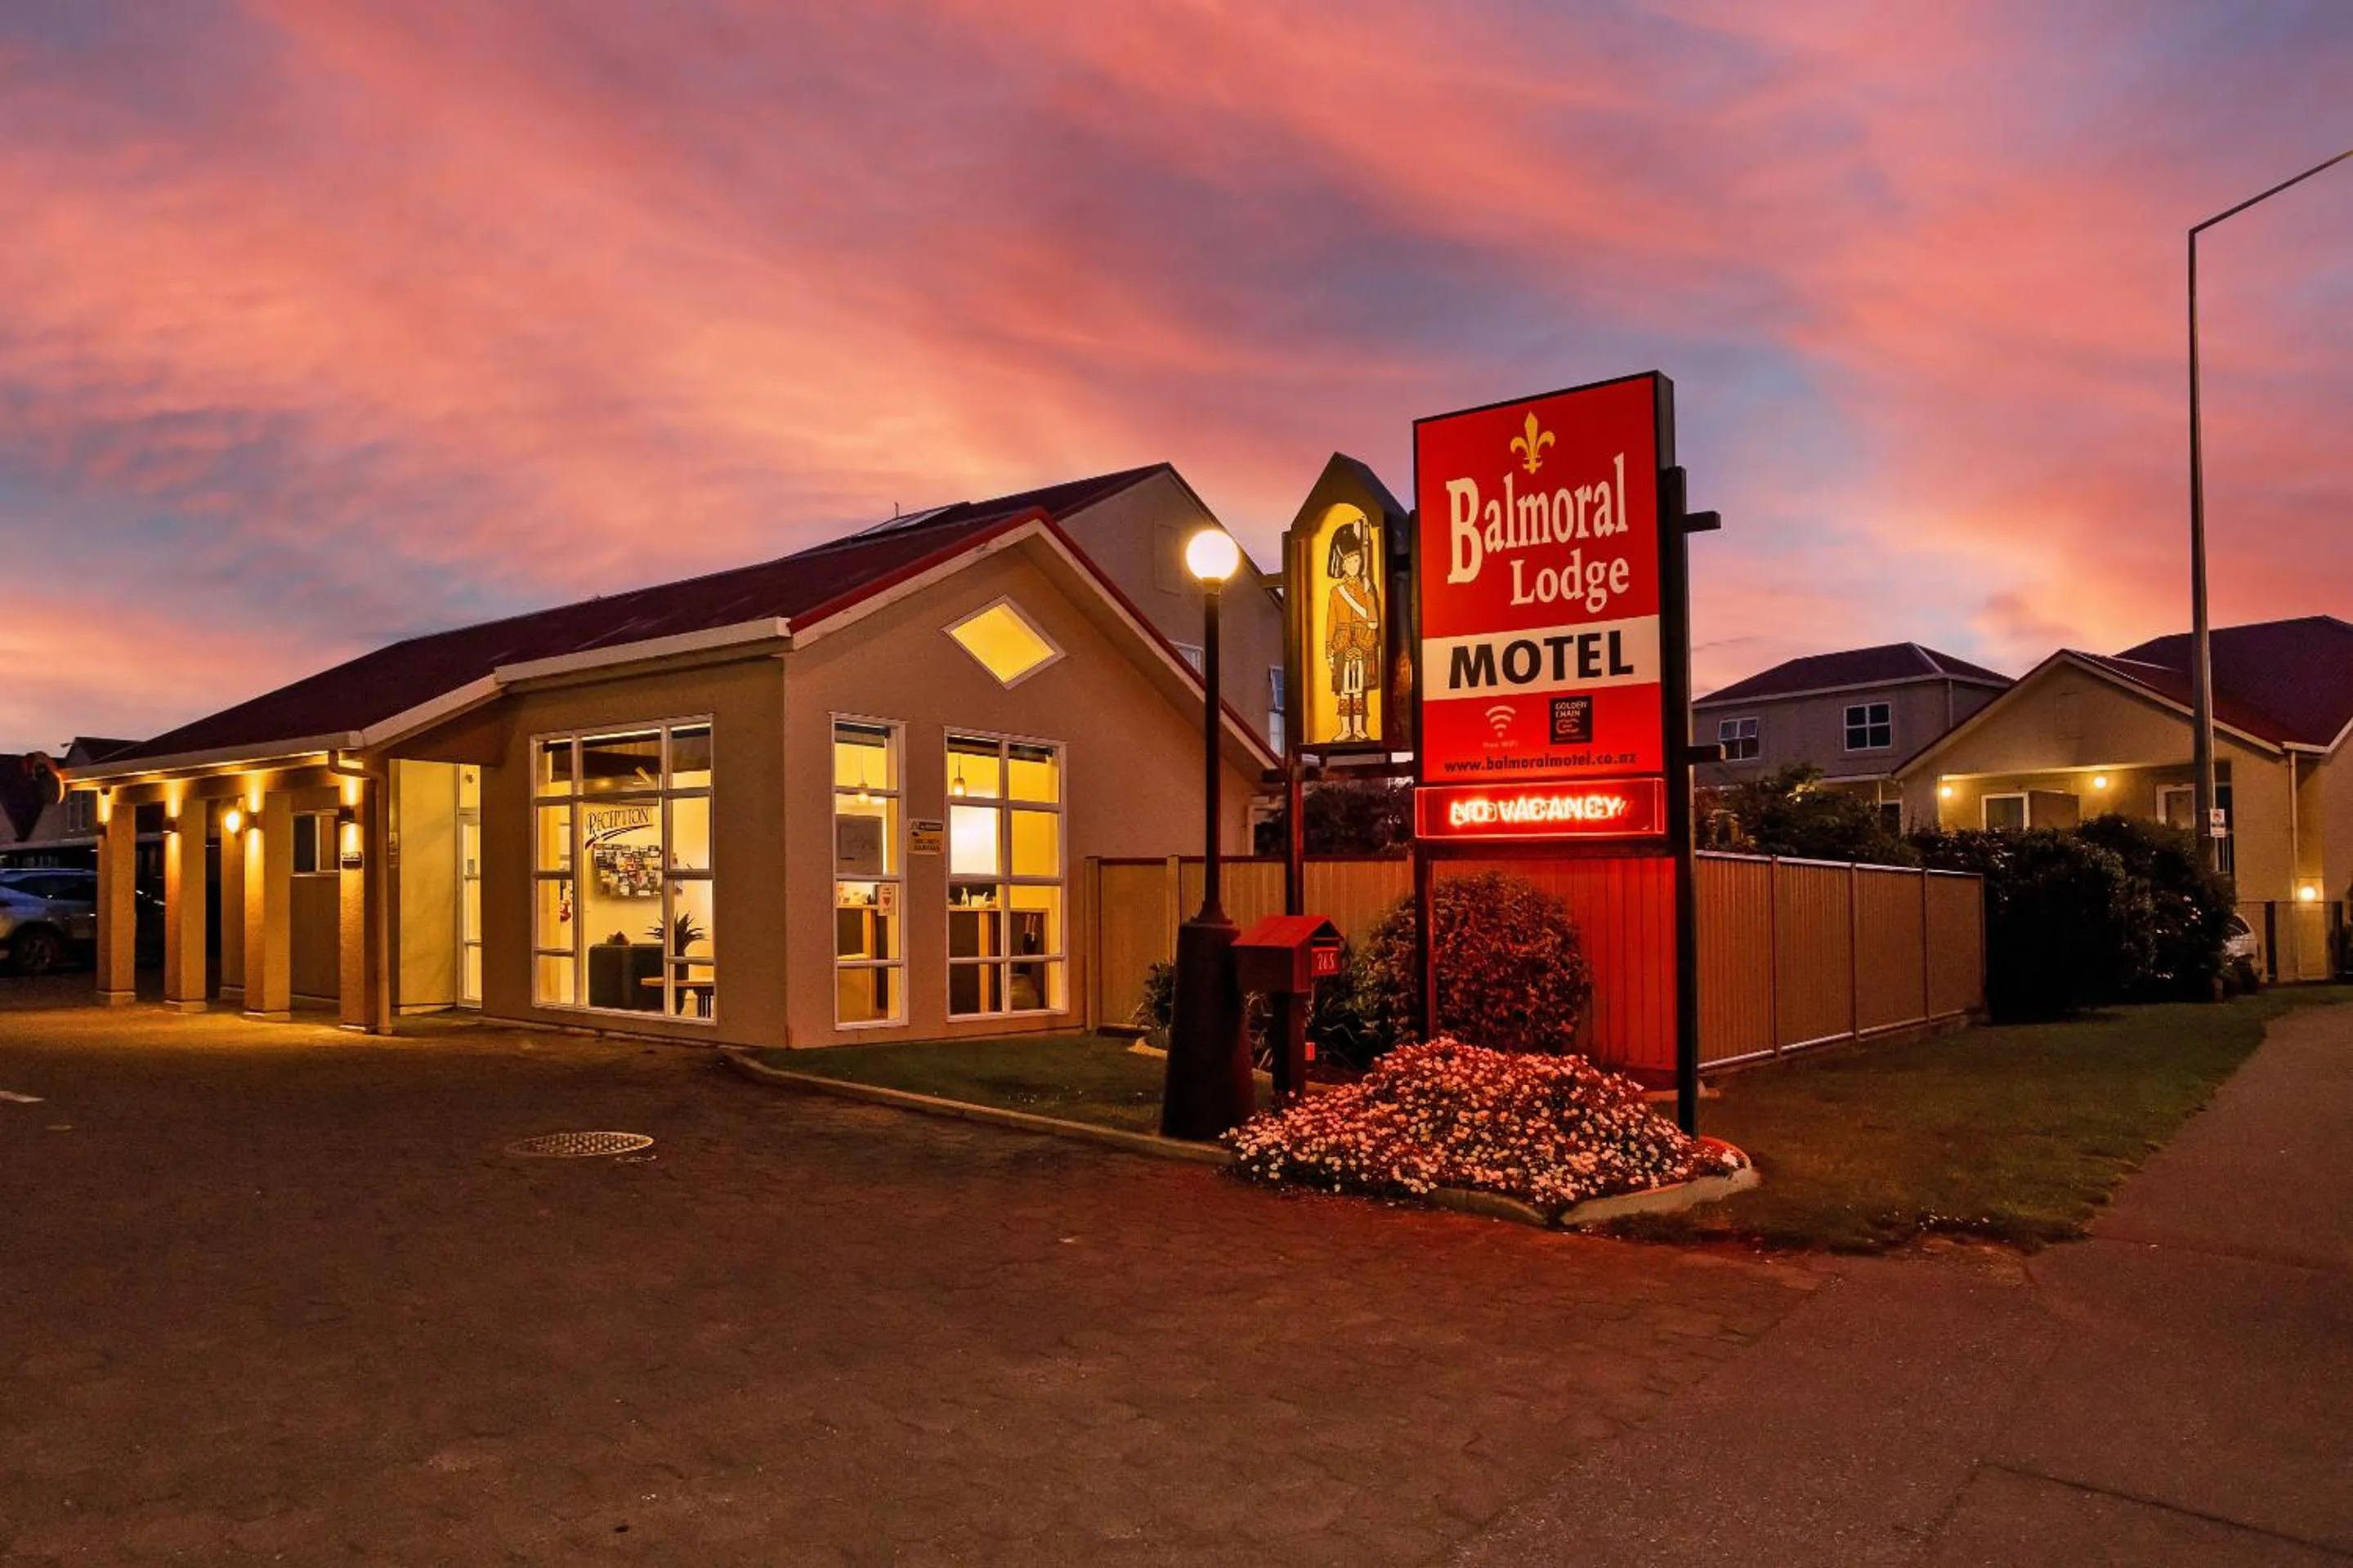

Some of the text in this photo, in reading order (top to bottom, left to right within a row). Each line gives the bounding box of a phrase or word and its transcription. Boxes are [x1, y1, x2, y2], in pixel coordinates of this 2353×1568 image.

[1446, 452, 1628, 584] Balmoral
[1510, 547, 1629, 613] Lodge
[1449, 630, 1634, 689] MOTEL
[1555, 700, 1587, 709] GOLDEN
[1444, 752, 1637, 772] www.balmoralmotel.co.nz
[588, 807, 652, 838] RECEPTION
[1450, 795, 1624, 826] NO VACANCY
